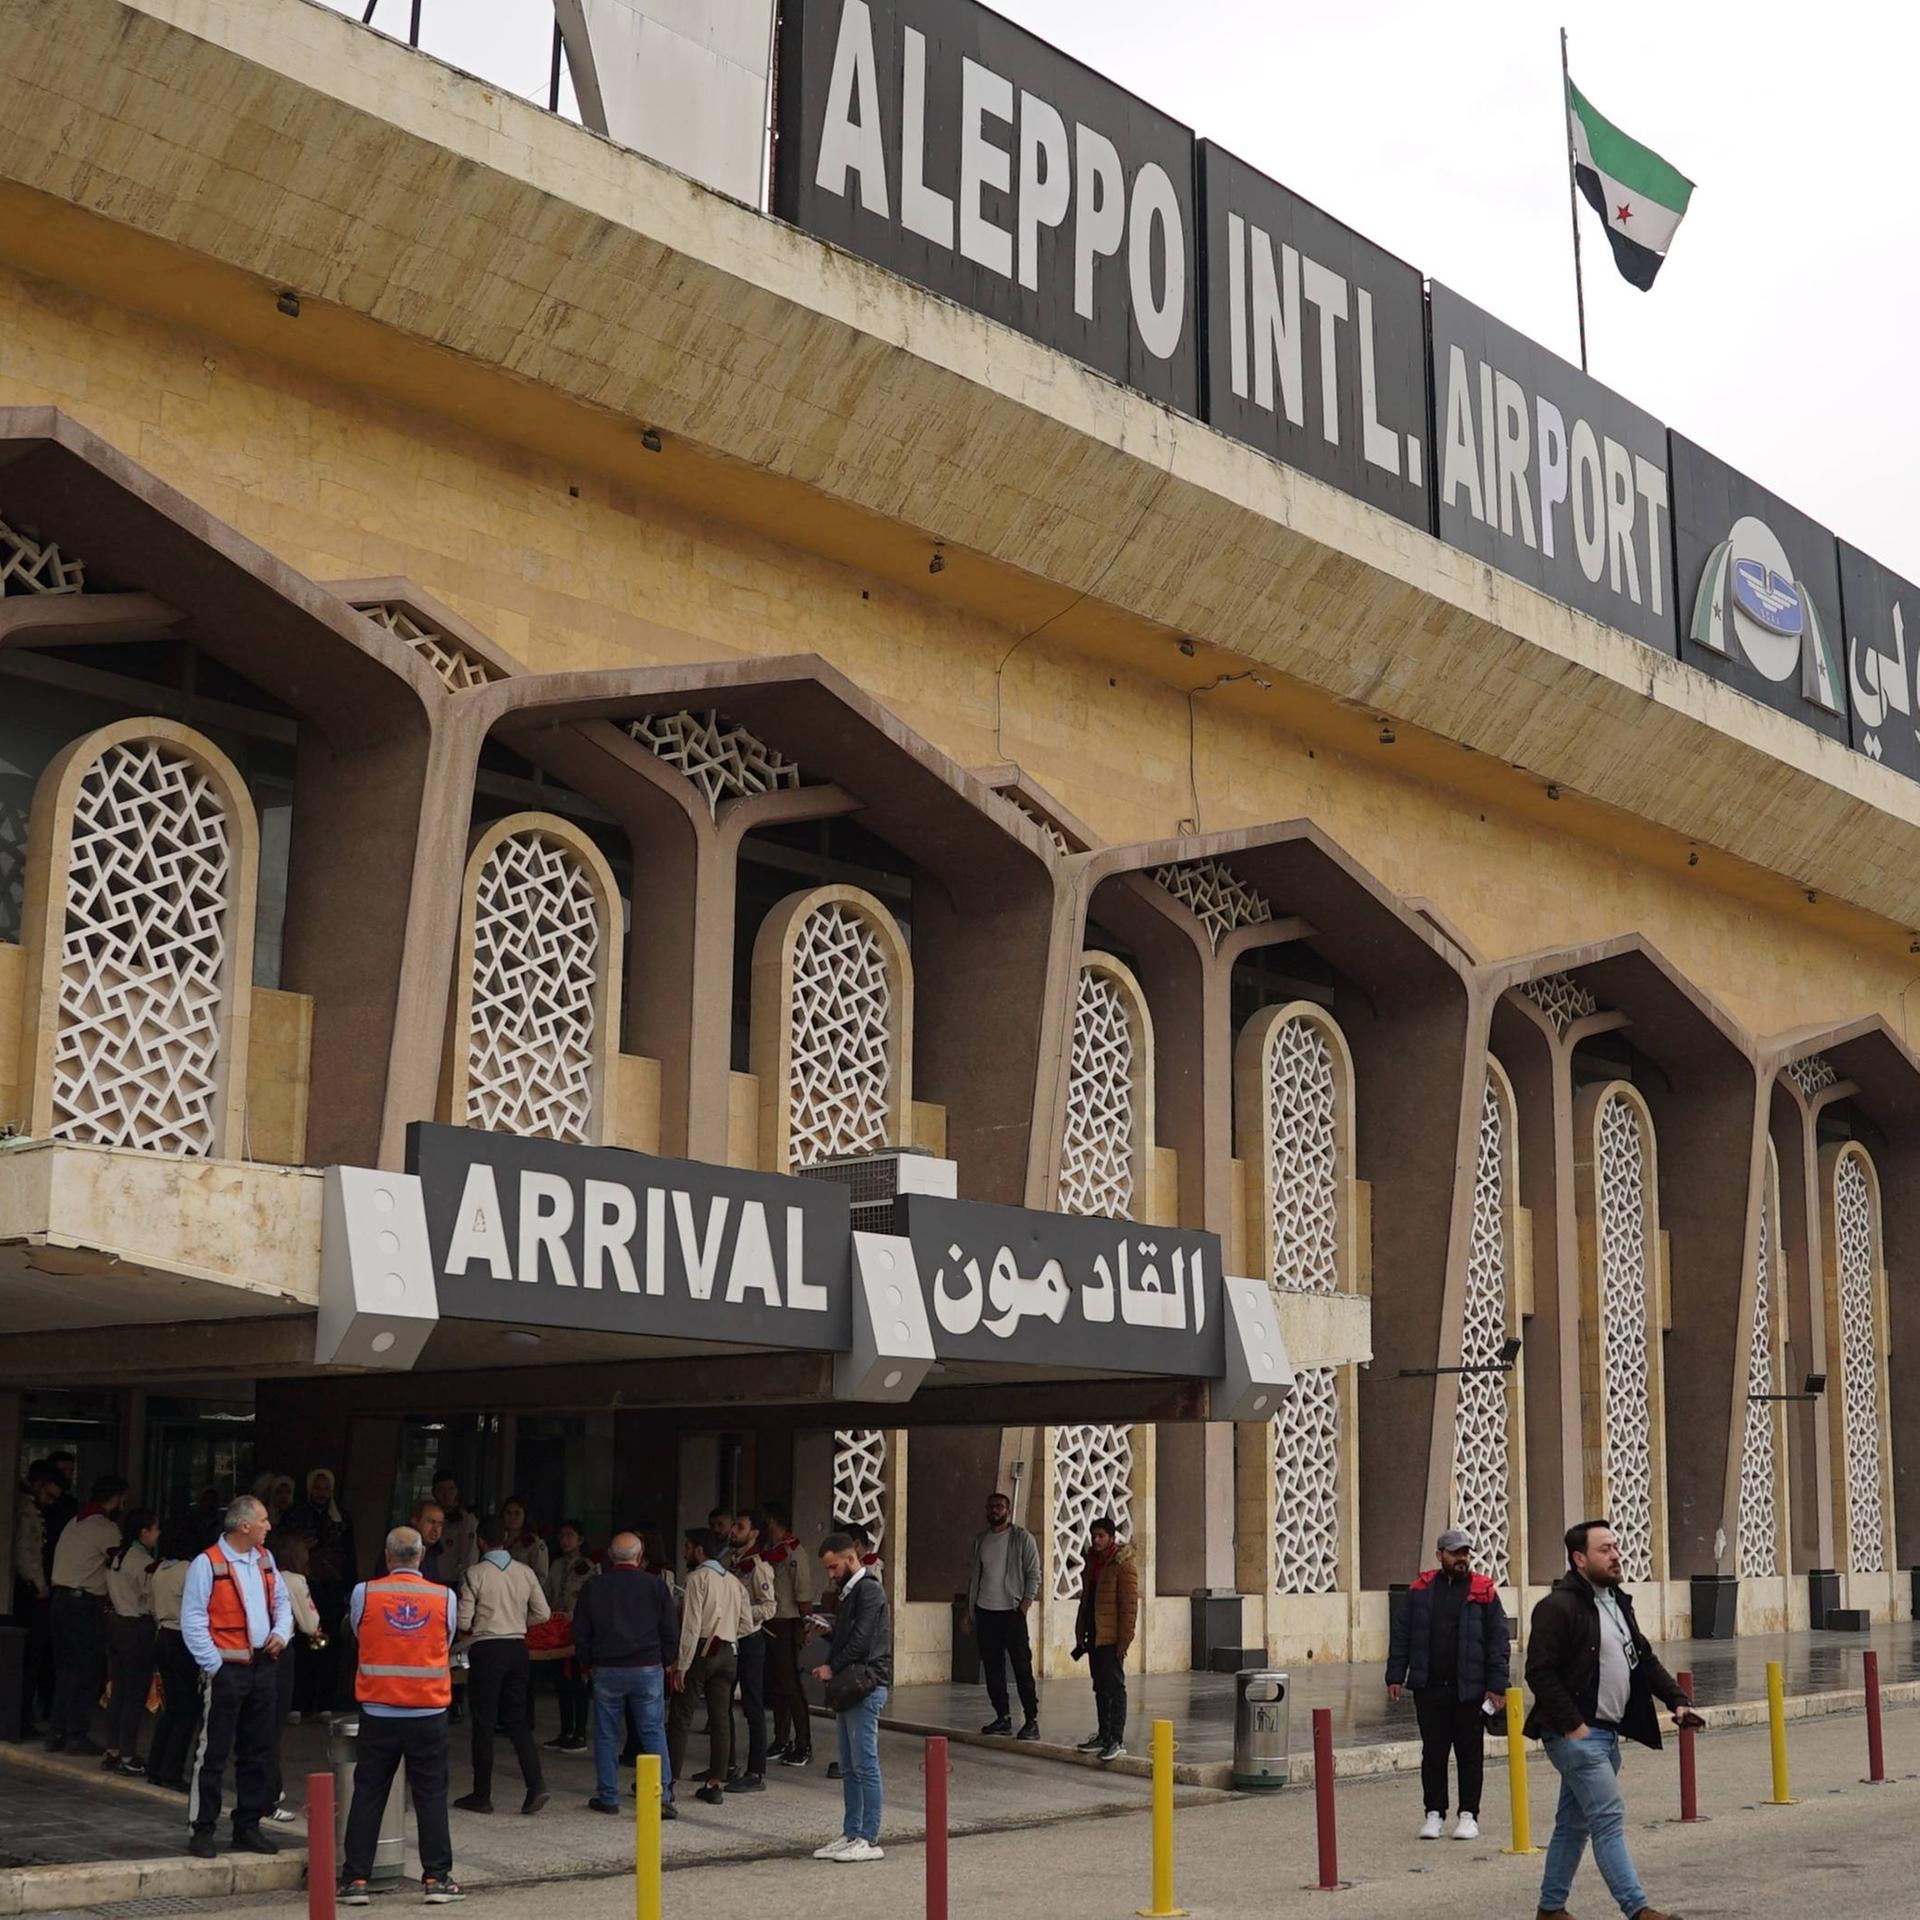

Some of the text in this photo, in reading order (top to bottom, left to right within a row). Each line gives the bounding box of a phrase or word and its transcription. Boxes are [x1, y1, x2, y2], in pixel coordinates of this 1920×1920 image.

[815, 0, 1668, 617] ALEPPO INTL. AIRPORT
[444, 1162, 828, 1312] ARRIVAL
